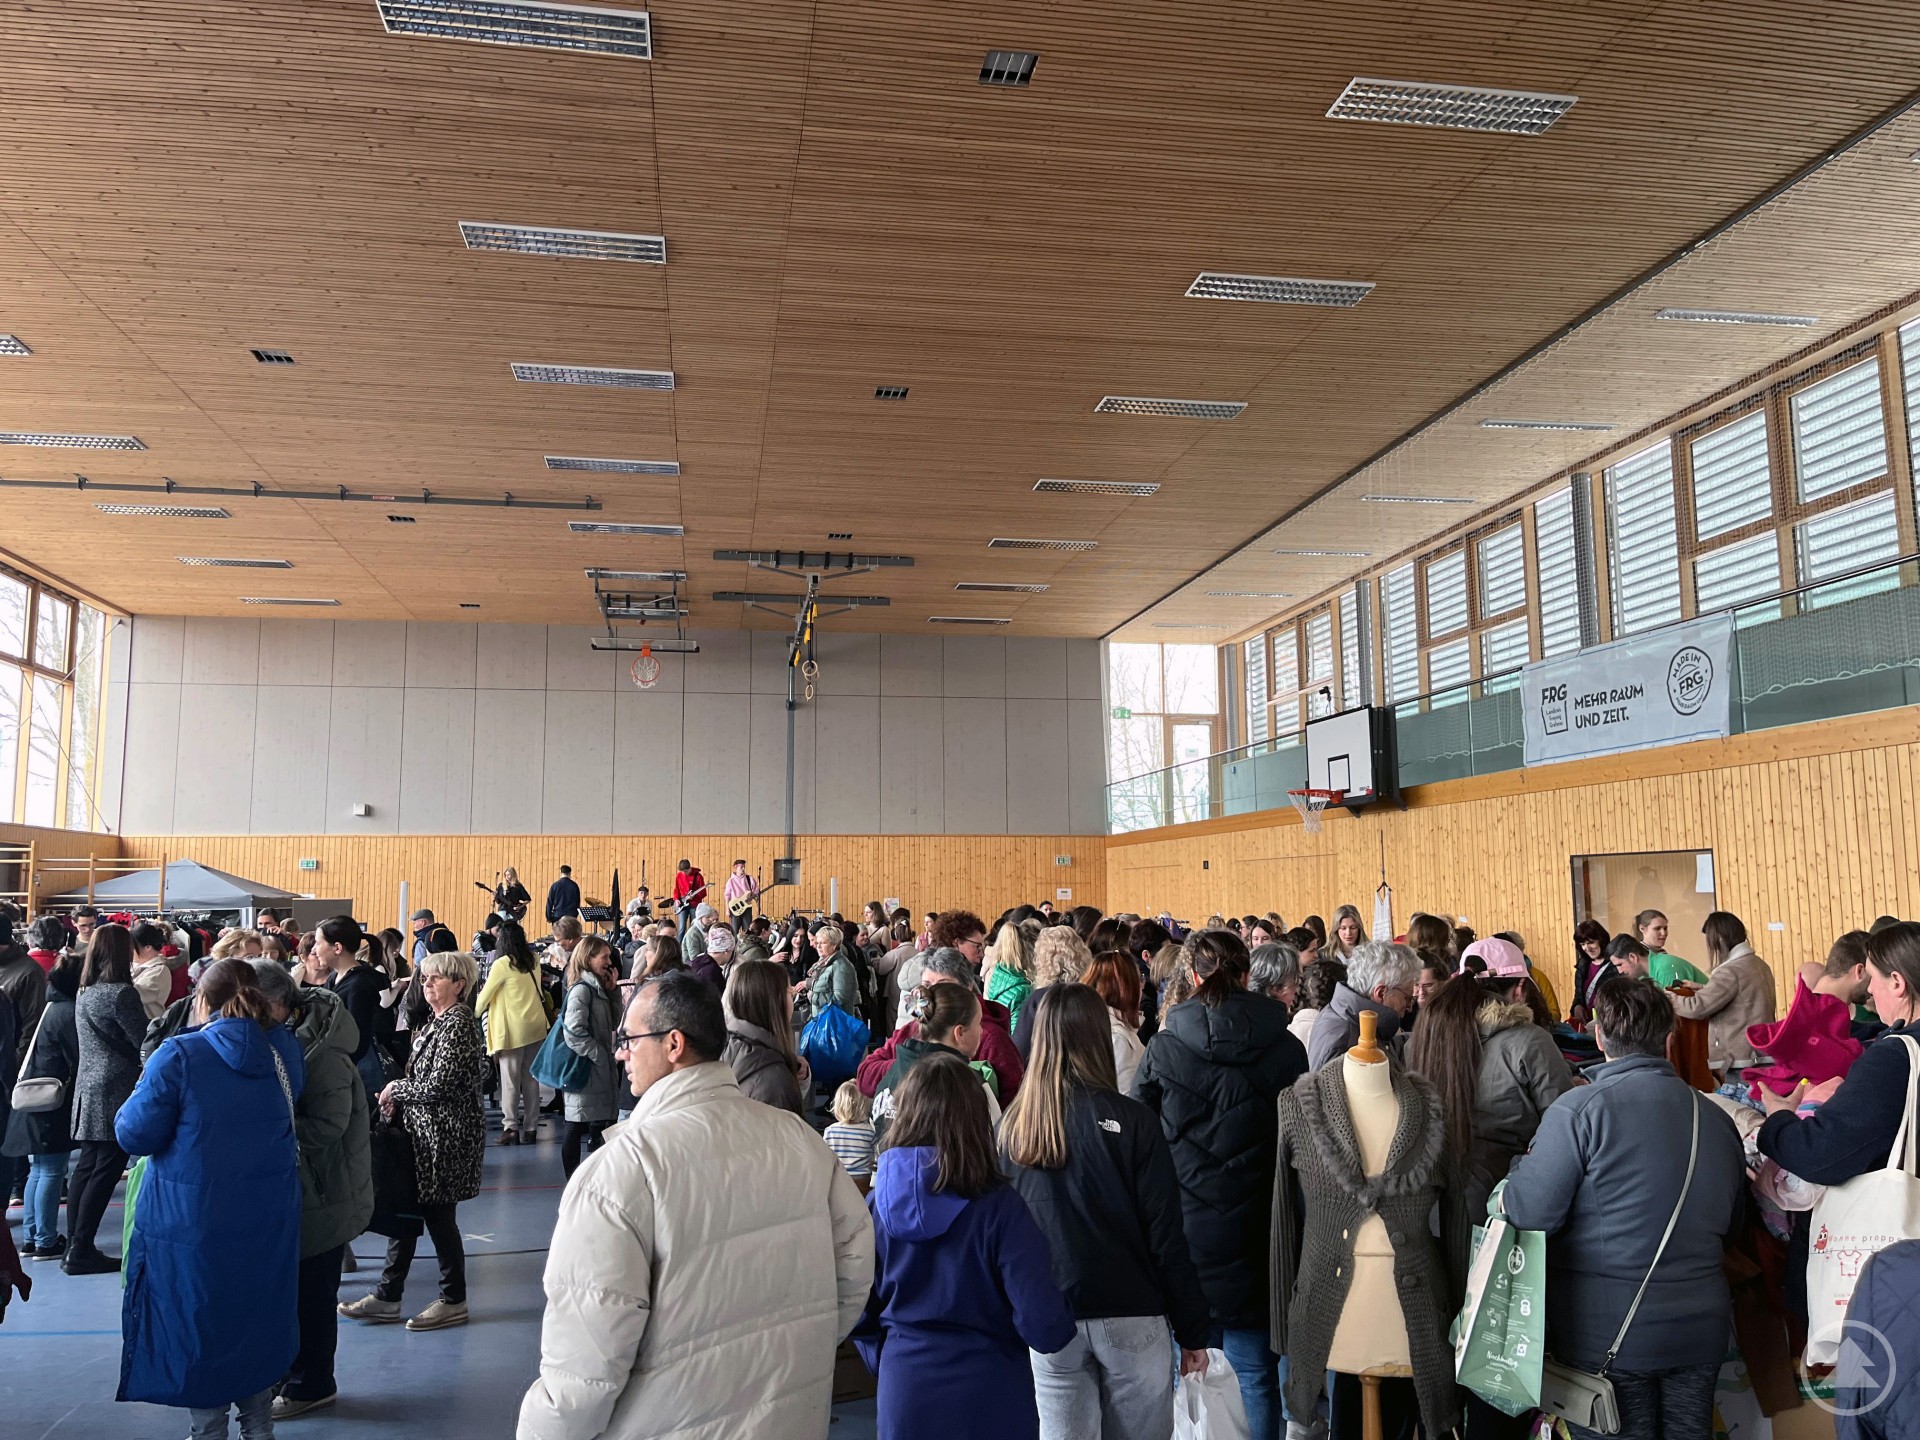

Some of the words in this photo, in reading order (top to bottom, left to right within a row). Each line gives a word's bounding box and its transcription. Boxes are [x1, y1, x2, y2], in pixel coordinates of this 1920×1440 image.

[1673, 653, 1689, 678] MADE
[1690, 653, 1701, 663] IN
[1679, 671, 1703, 694] FRG
[1541, 684, 1567, 705] FRG
[1574, 691, 1607, 710] MEHR
[1610, 683, 1643, 703] RAUM
[1575, 712, 1600, 729] UND
[1603, 707, 1629, 725] ZEIT.
